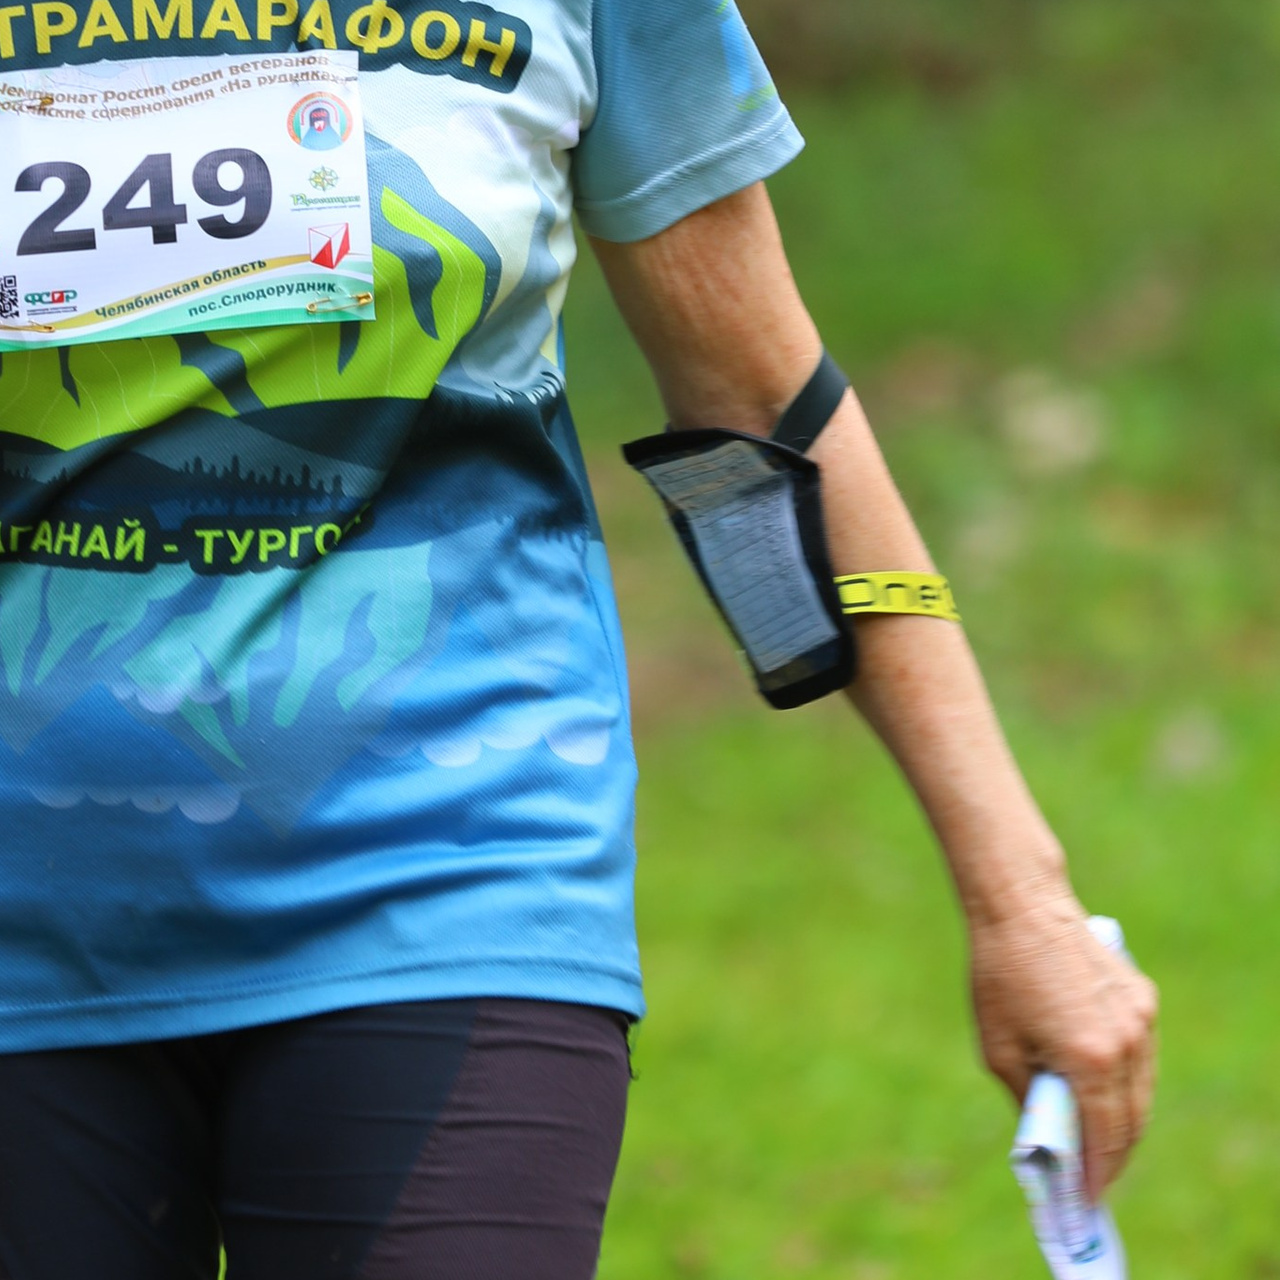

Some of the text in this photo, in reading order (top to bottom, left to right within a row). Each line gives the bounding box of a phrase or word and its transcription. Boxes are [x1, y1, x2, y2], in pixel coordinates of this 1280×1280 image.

[91, 87, 215, 120] соревнования
[103, 83, 166, 103] России
[171, 69, 224, 92] среди
[228, 55, 329, 77] ветеранов
[14, 147, 273, 256] 249
[95, 258, 268, 320] Челябинская область
[195, 506, 366, 566] ТУРГО
